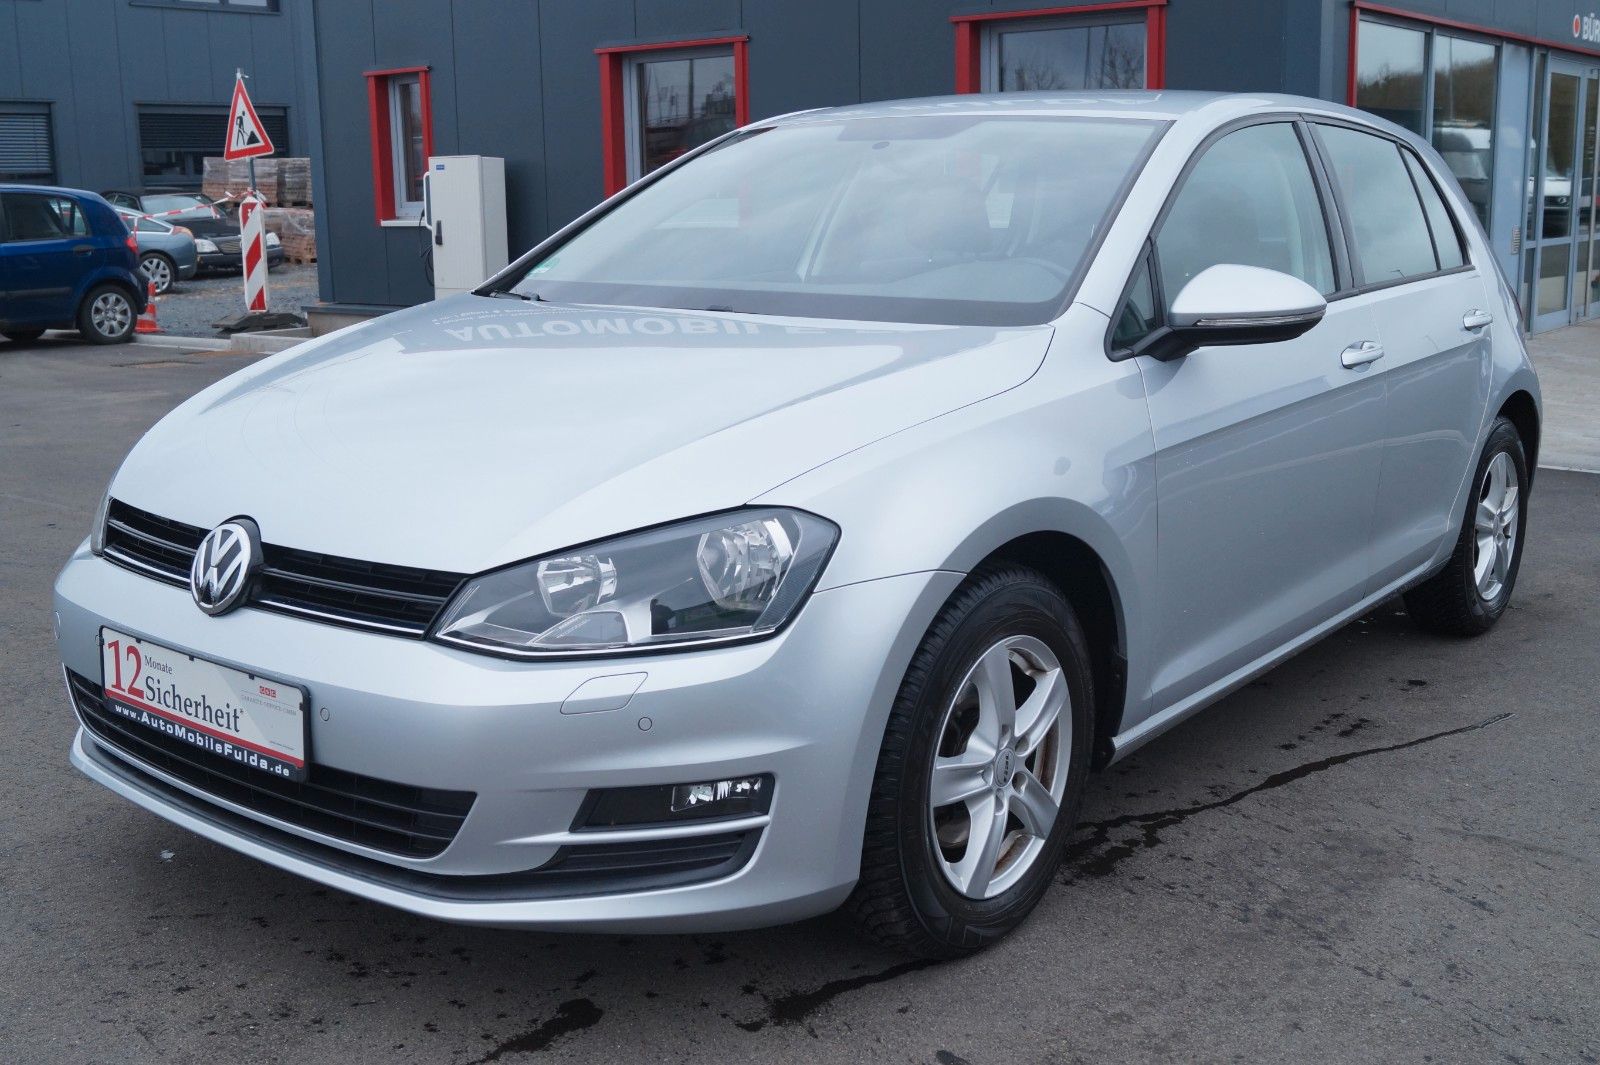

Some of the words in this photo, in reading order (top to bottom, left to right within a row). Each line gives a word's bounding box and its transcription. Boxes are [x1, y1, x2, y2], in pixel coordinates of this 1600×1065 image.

[107, 639, 145, 700] 12
[145, 654, 173, 675] Monate
[114, 704, 290, 777] www.AutoMobileFulda.de
